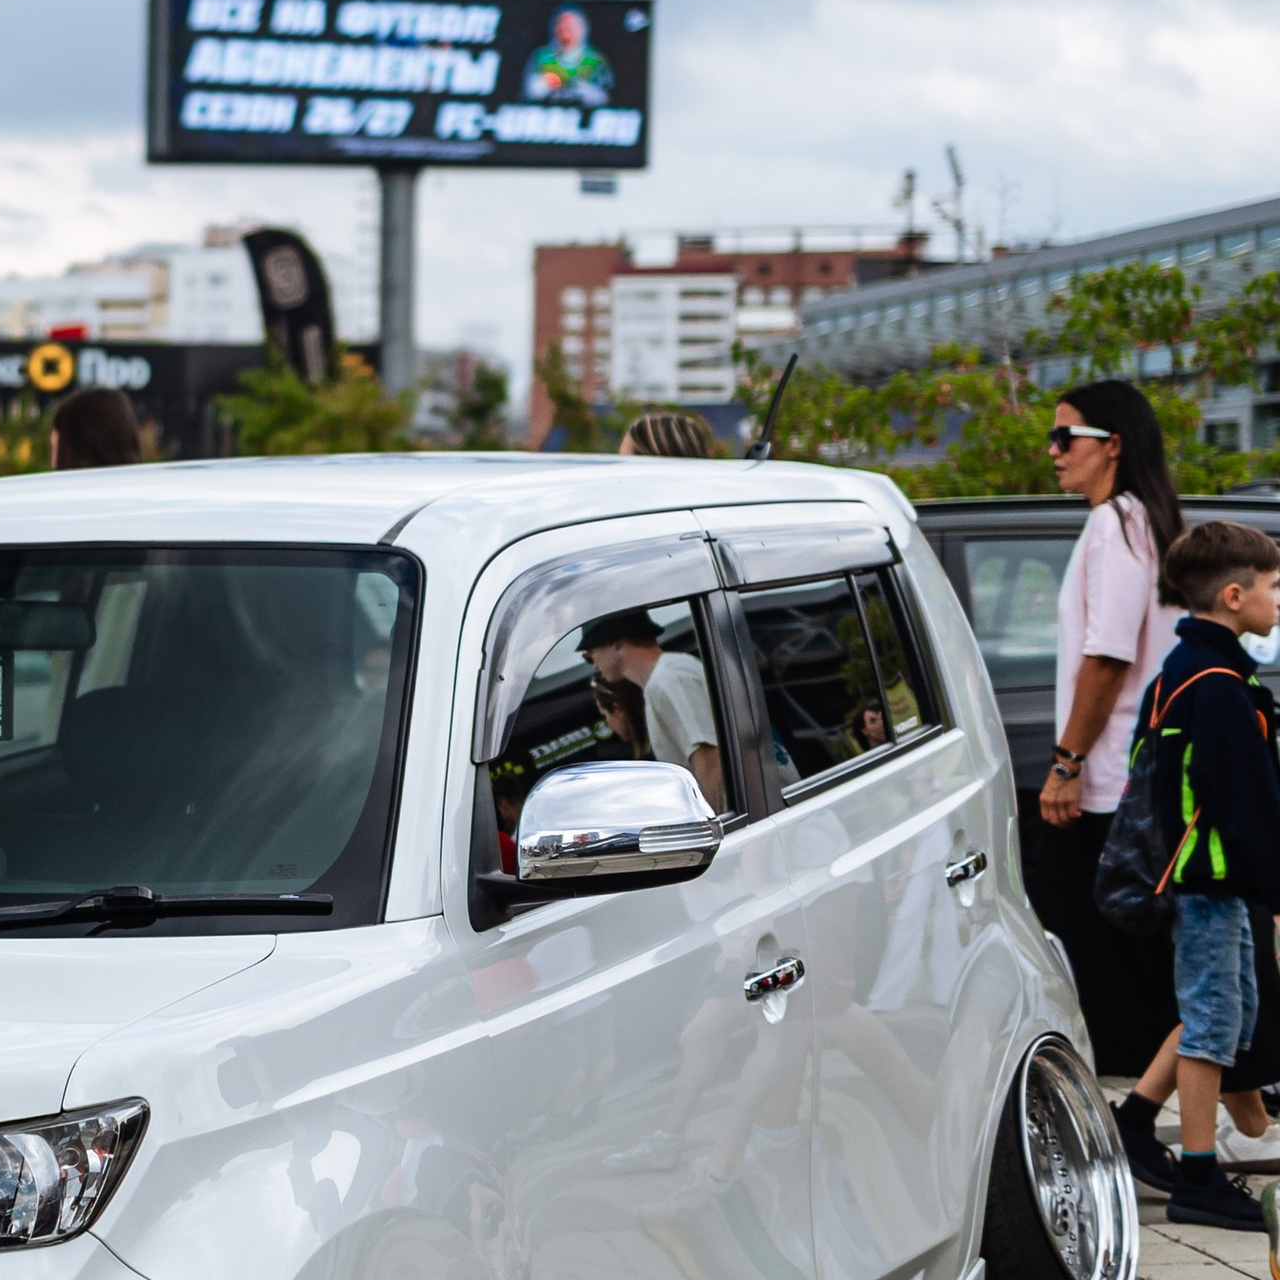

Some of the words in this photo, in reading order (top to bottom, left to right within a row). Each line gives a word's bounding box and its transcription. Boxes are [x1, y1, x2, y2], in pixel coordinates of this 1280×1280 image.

[185, 37, 500, 95] АБОНЕМЕНТЫ
[181, 91, 298, 134] СЕЗОН
[79, 347, 152, 391] Про
